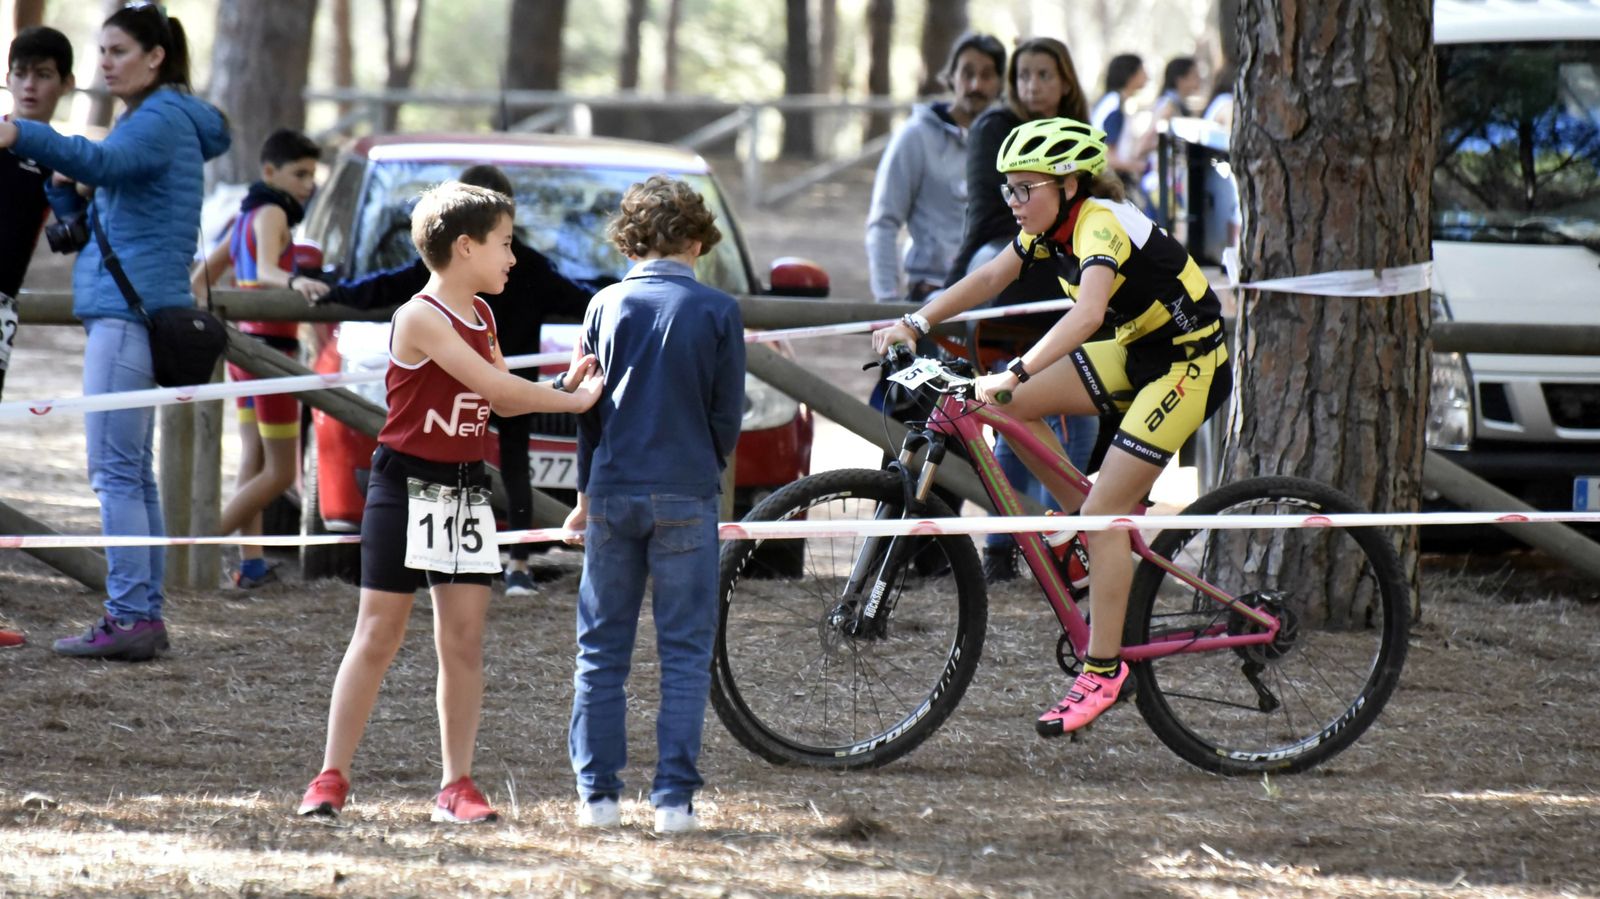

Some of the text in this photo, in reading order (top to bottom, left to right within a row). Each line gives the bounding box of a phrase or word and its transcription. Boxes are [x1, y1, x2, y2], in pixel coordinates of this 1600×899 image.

[1063, 163, 1072, 171] 35
[419, 513, 483, 554] 115
[863, 580, 887, 618] ROCKSHOX
